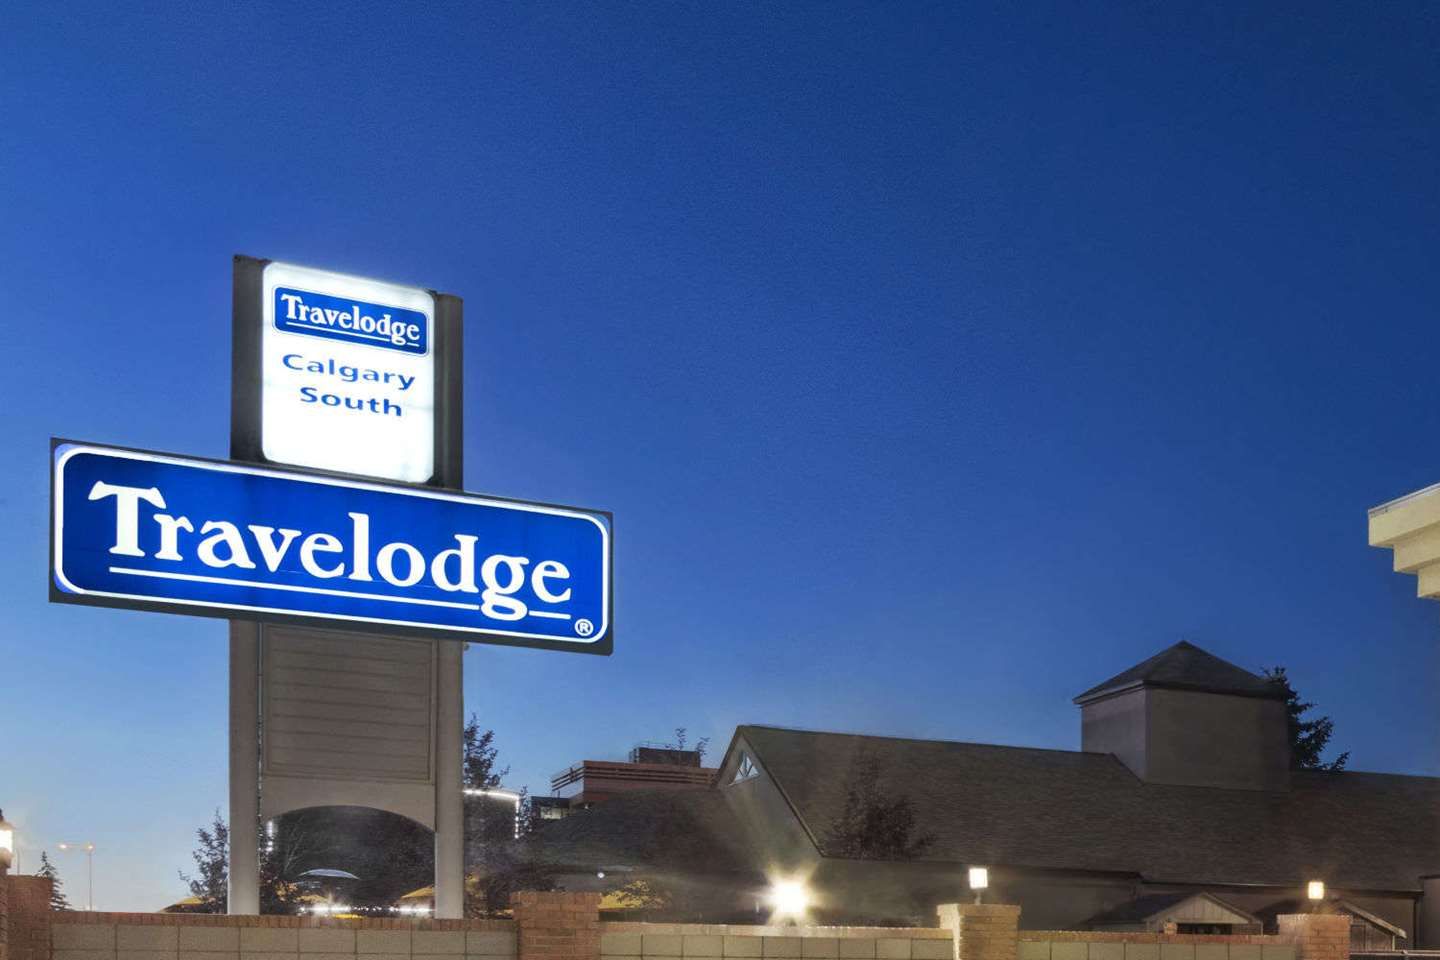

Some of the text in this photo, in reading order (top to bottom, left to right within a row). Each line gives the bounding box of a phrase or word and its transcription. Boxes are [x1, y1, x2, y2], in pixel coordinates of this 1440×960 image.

[280, 293, 420, 346] Travelodge
[282, 353, 416, 391] Calgary
[299, 386, 403, 417] South
[88, 480, 571, 621] Travelodge
